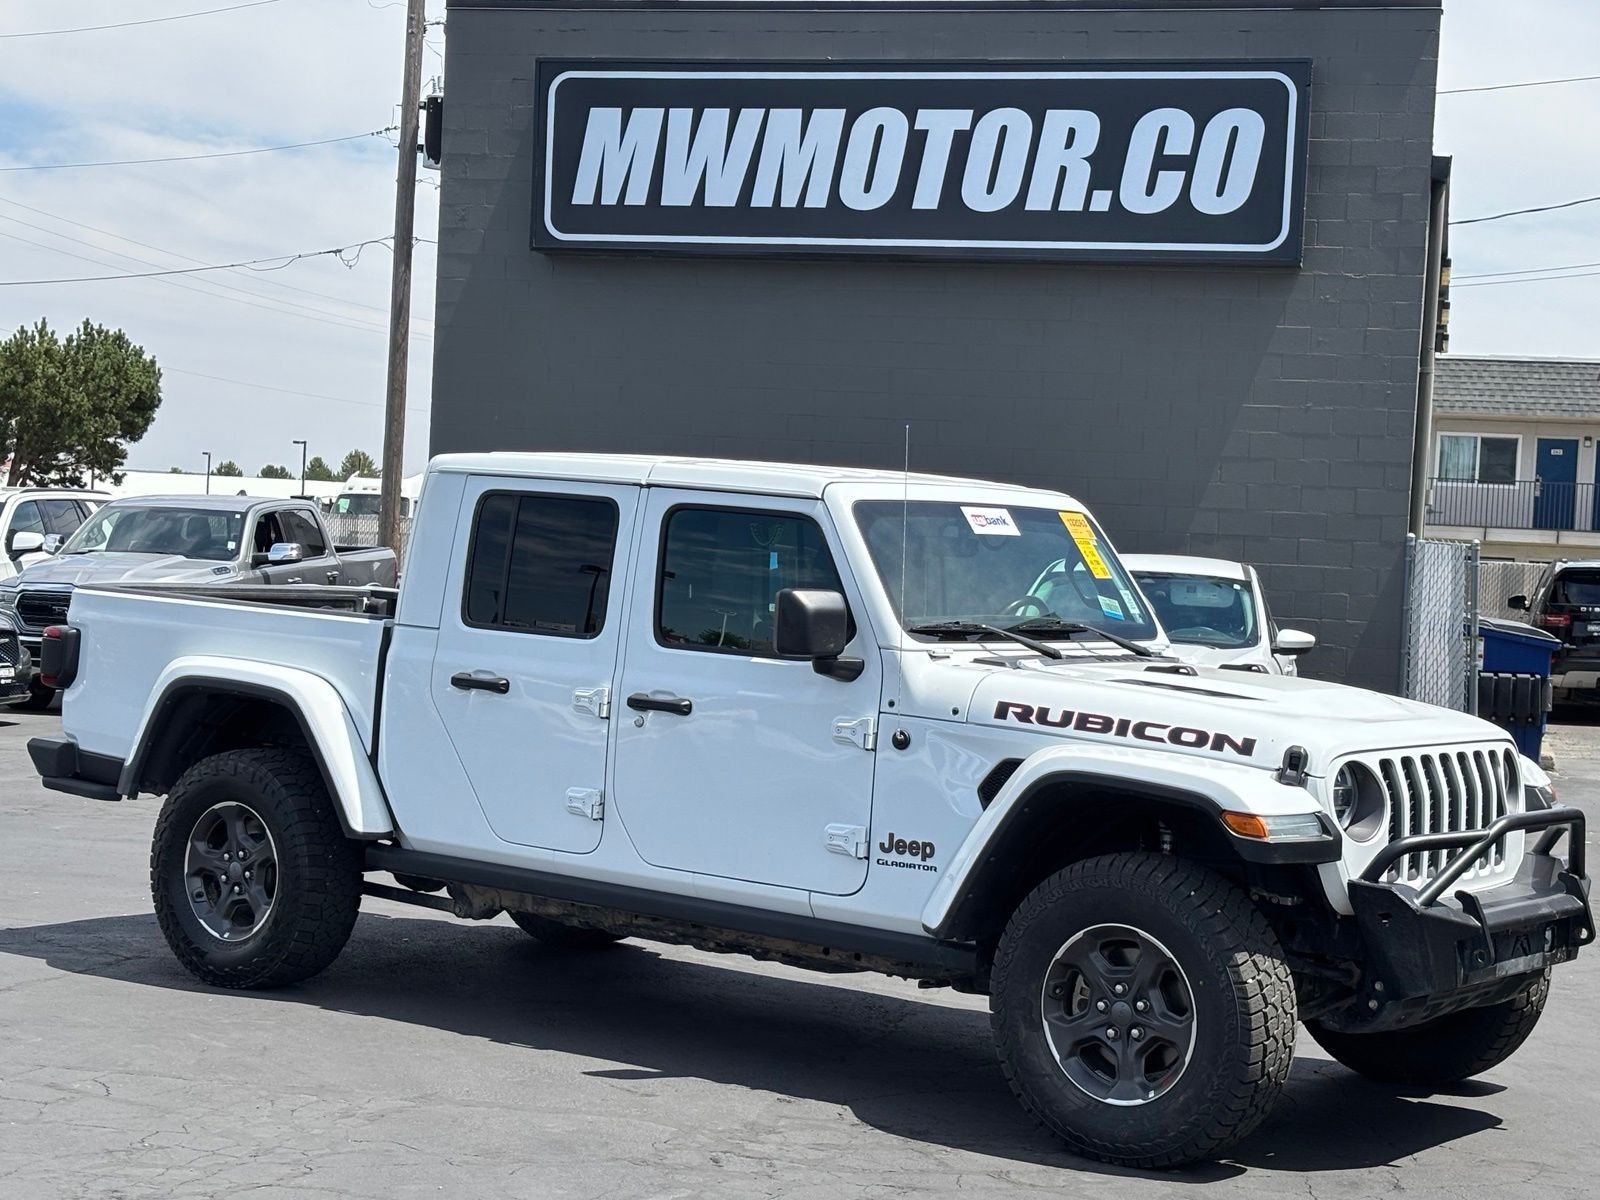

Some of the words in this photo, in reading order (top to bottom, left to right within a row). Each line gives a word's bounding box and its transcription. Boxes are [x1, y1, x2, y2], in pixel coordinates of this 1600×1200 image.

[571, 106, 1265, 215] MWMOTOR.CO
[994, 700, 1257, 757] RUBICON
[876, 858, 938, 872] GLADIATOR
[879, 832, 935, 862] Jeep
